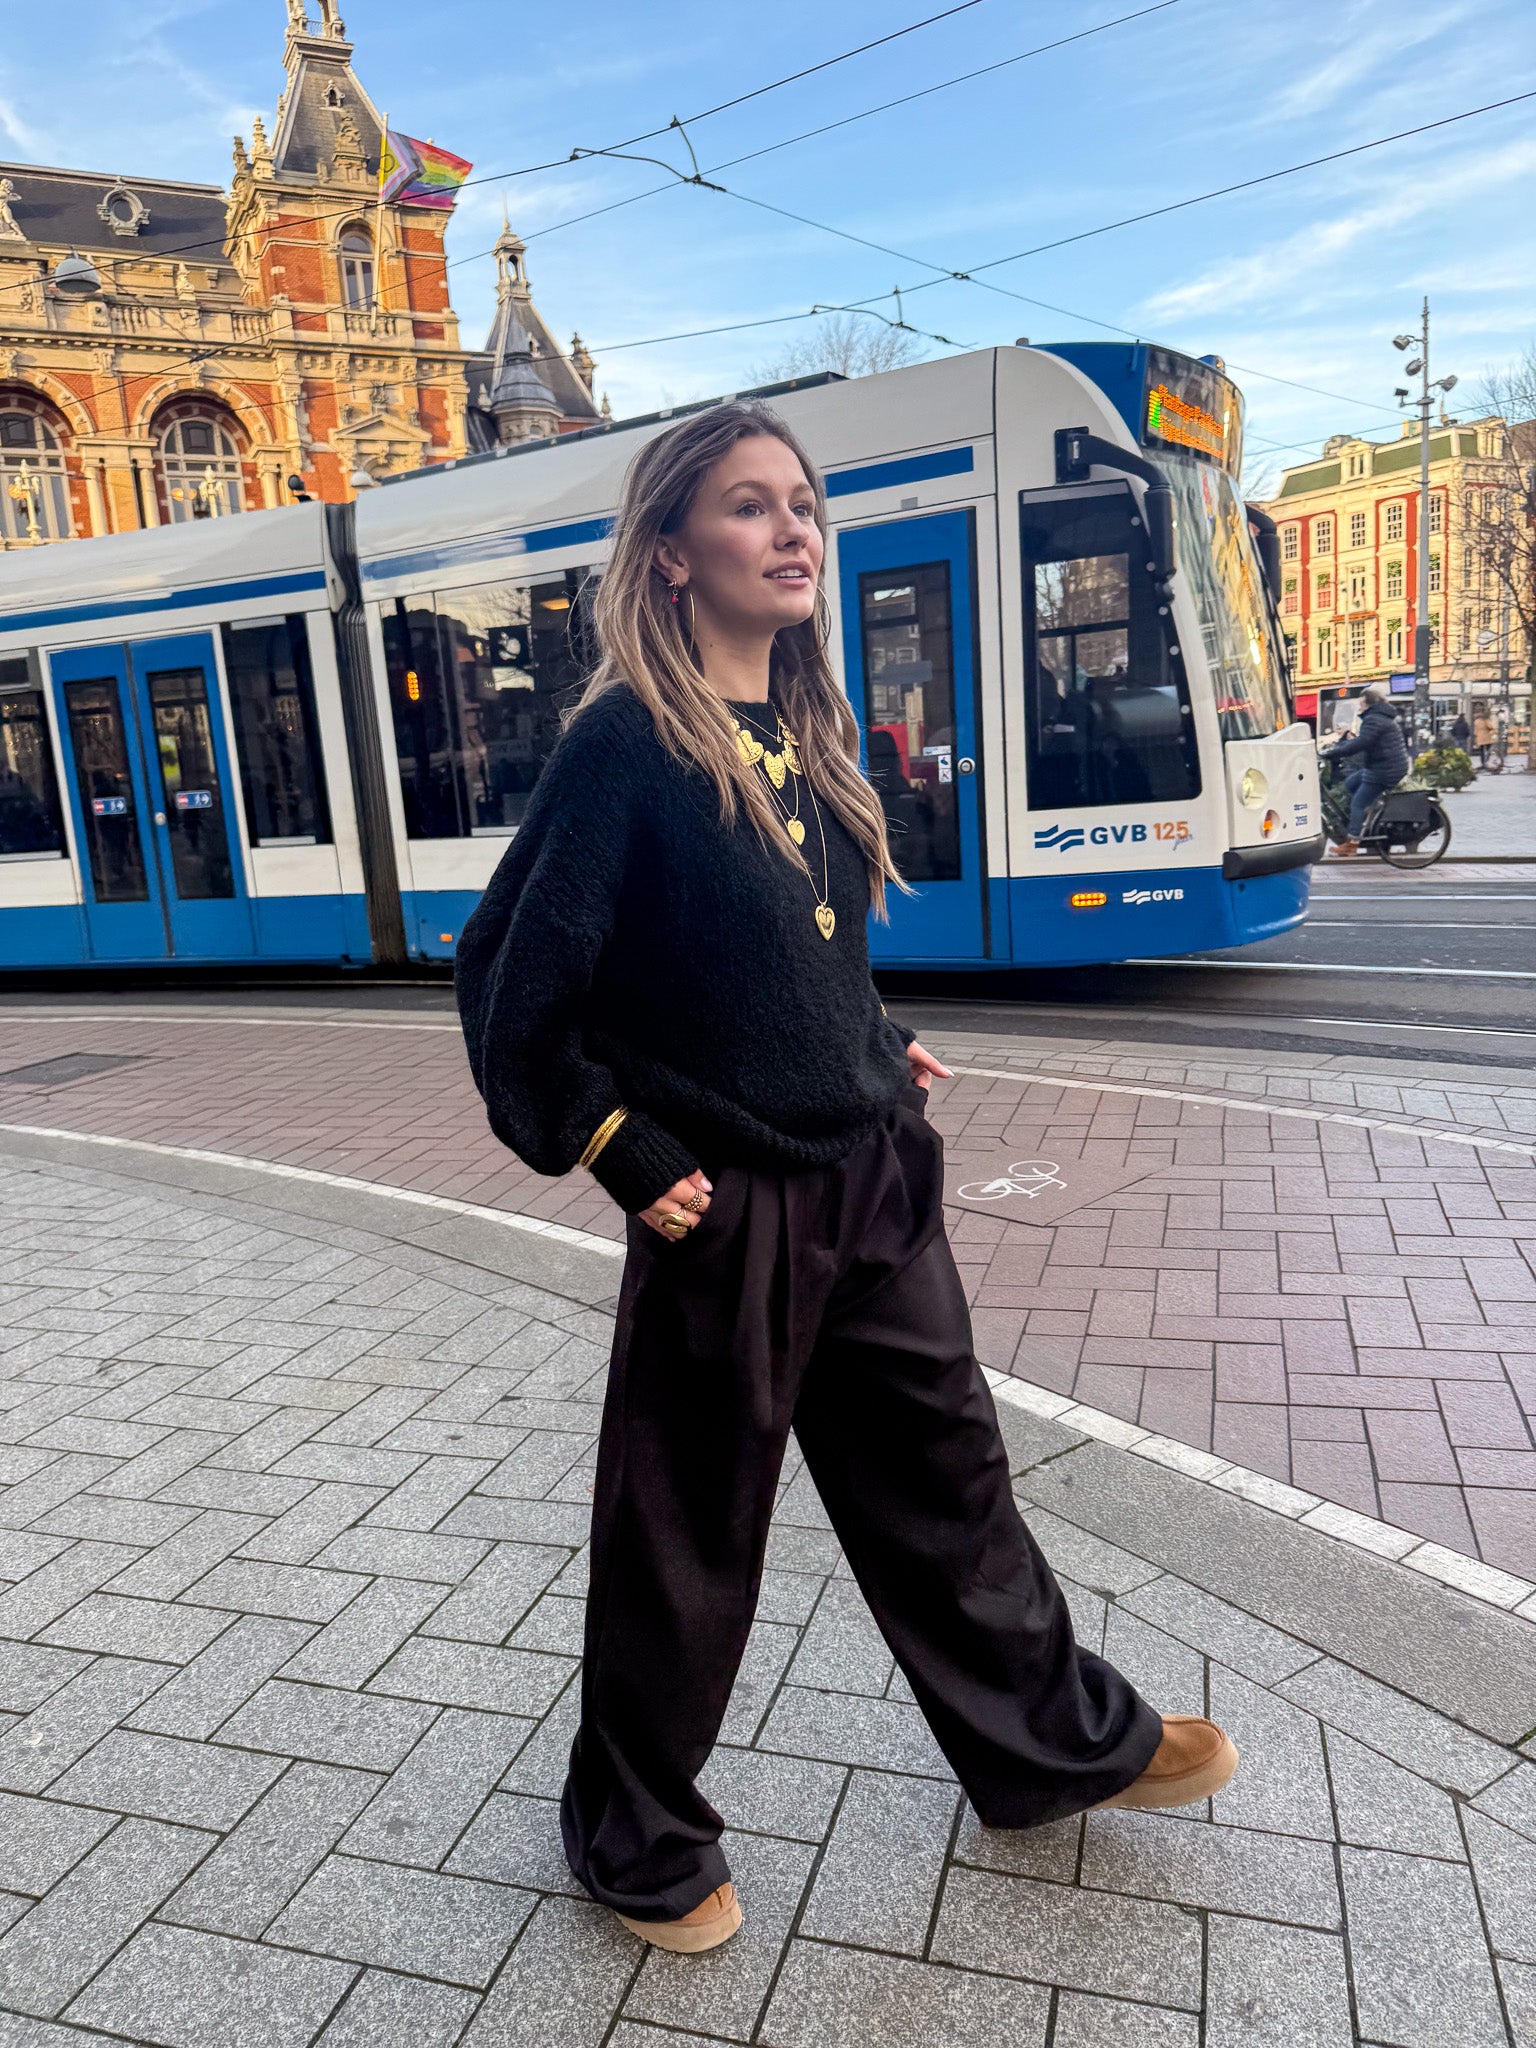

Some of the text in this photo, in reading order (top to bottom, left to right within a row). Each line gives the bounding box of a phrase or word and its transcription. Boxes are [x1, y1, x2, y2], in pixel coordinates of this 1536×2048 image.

[1091, 821, 1189, 845] GVB 125
[1153, 889, 1184, 901] GVB
